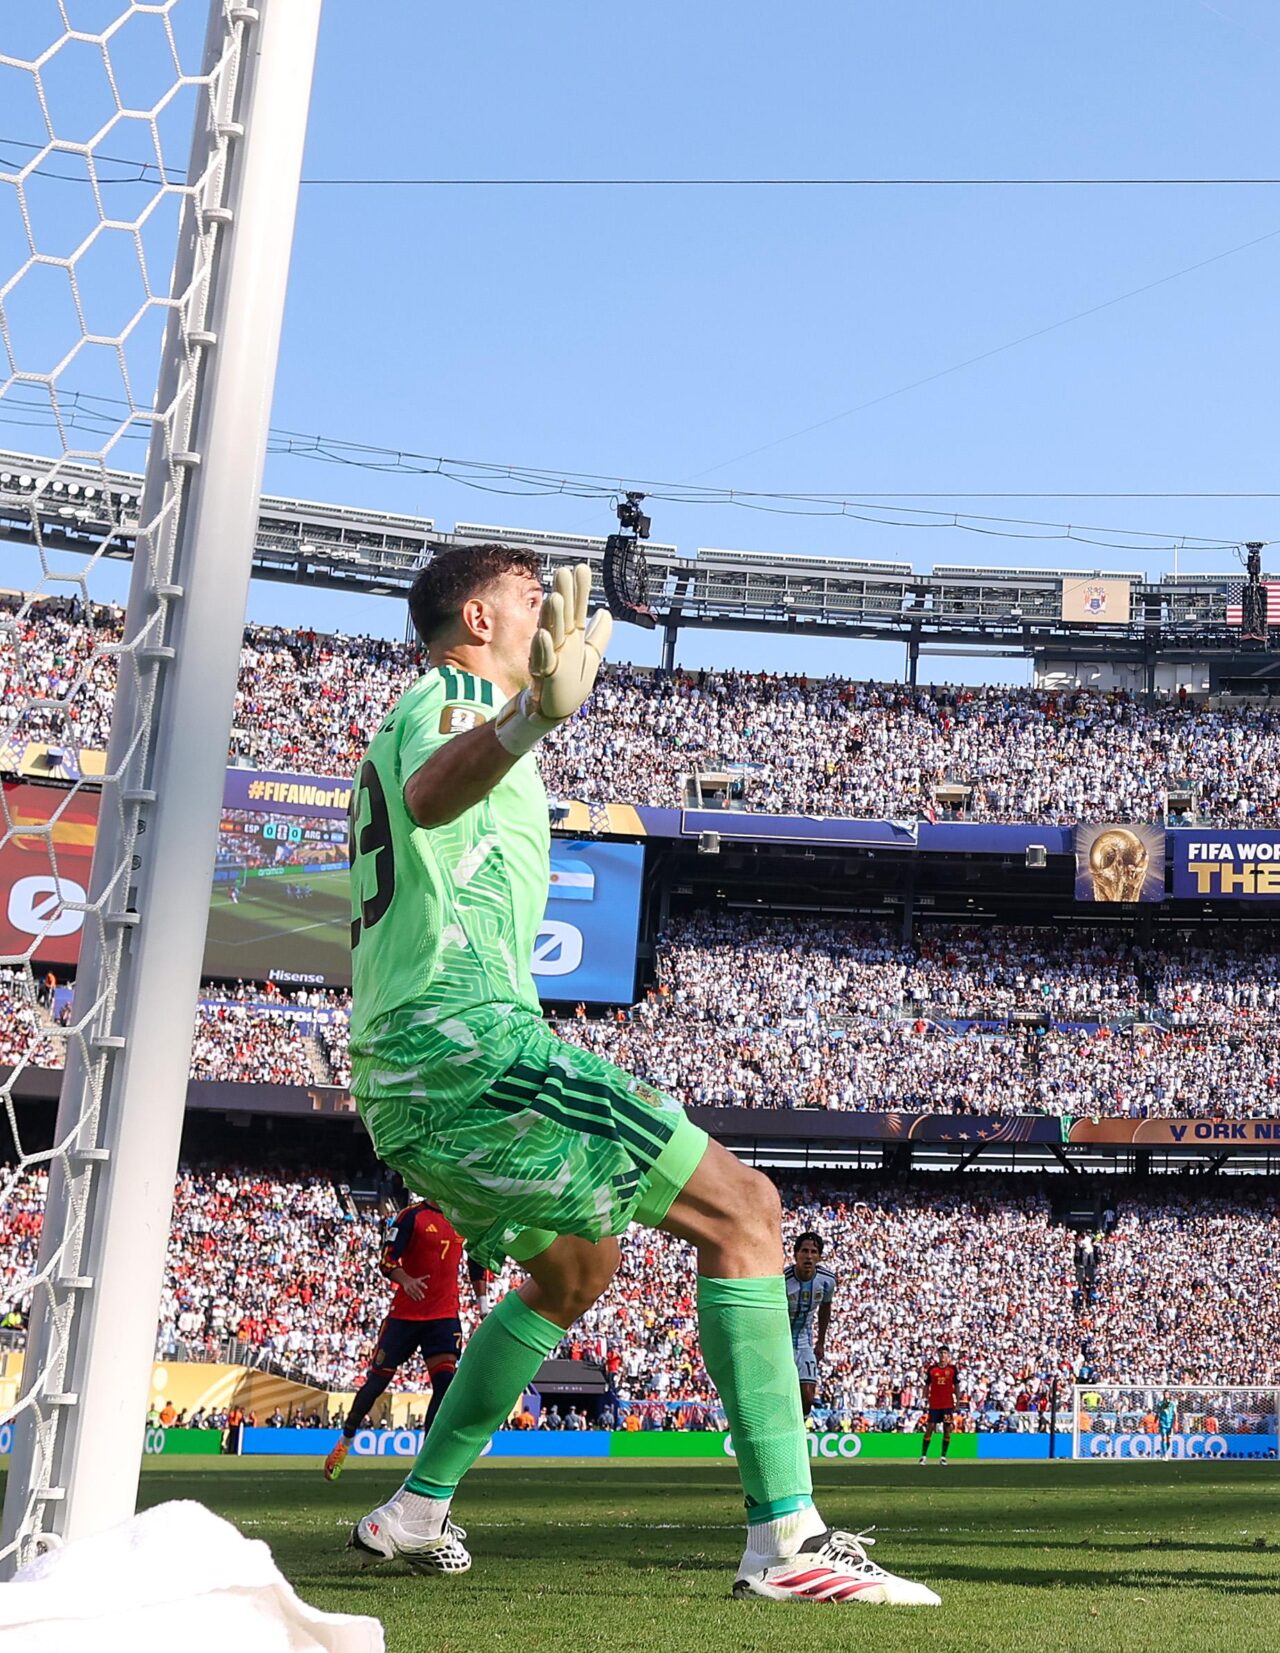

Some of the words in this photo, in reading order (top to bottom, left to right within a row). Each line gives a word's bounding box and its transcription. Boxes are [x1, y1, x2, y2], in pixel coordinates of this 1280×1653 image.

[244, 825, 259, 833] ESP
[304, 830, 321, 840] ARG
[1188, 843, 1234, 860] FIFA
[268, 969, 324, 984] Hisense
[440, 1240, 450, 1260] 7
[453, 1333, 461, 1349] 7
